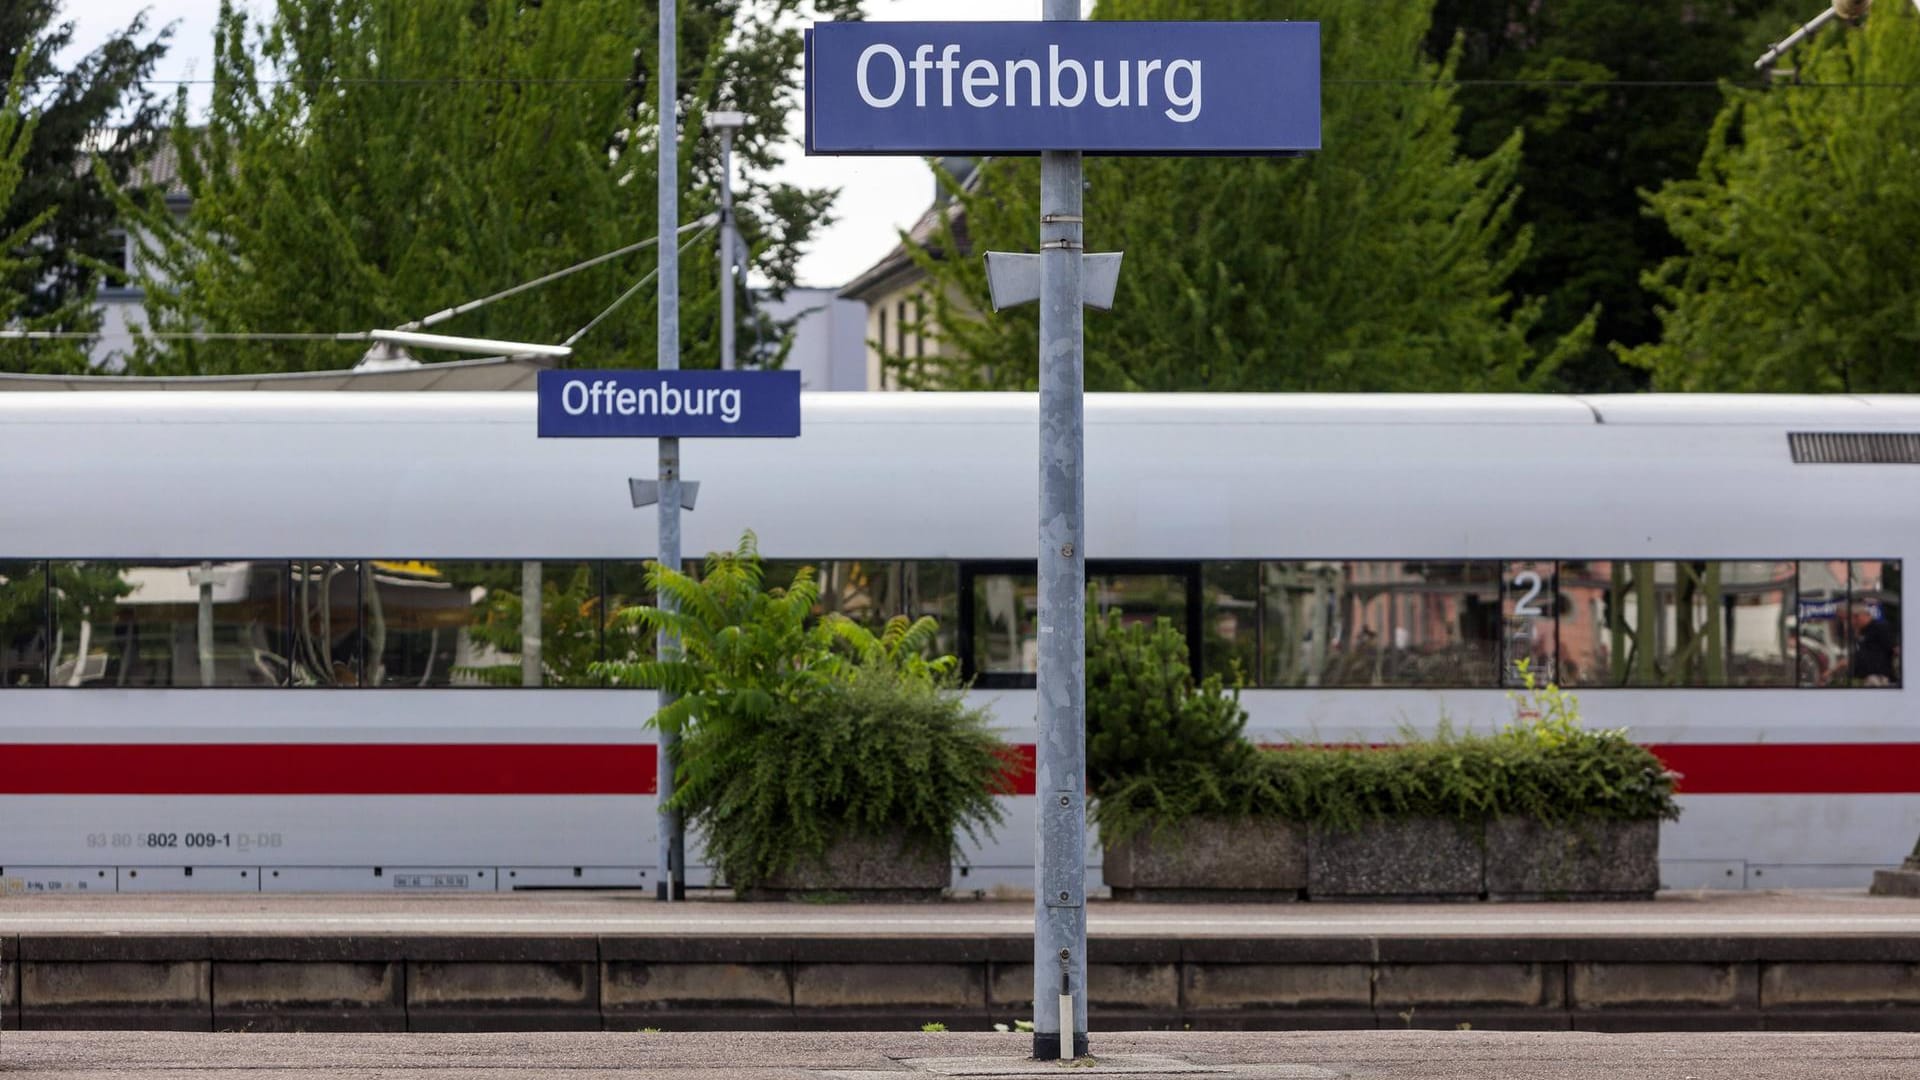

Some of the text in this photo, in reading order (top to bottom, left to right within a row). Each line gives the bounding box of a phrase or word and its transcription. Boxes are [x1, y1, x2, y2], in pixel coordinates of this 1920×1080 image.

[856, 43, 1202, 123] Offenburg
[562, 380, 741, 423] Offenburg
[1514, 570, 1542, 615] 2
[86, 832, 282, 852] 93 80 5802 009-1 D-DB
